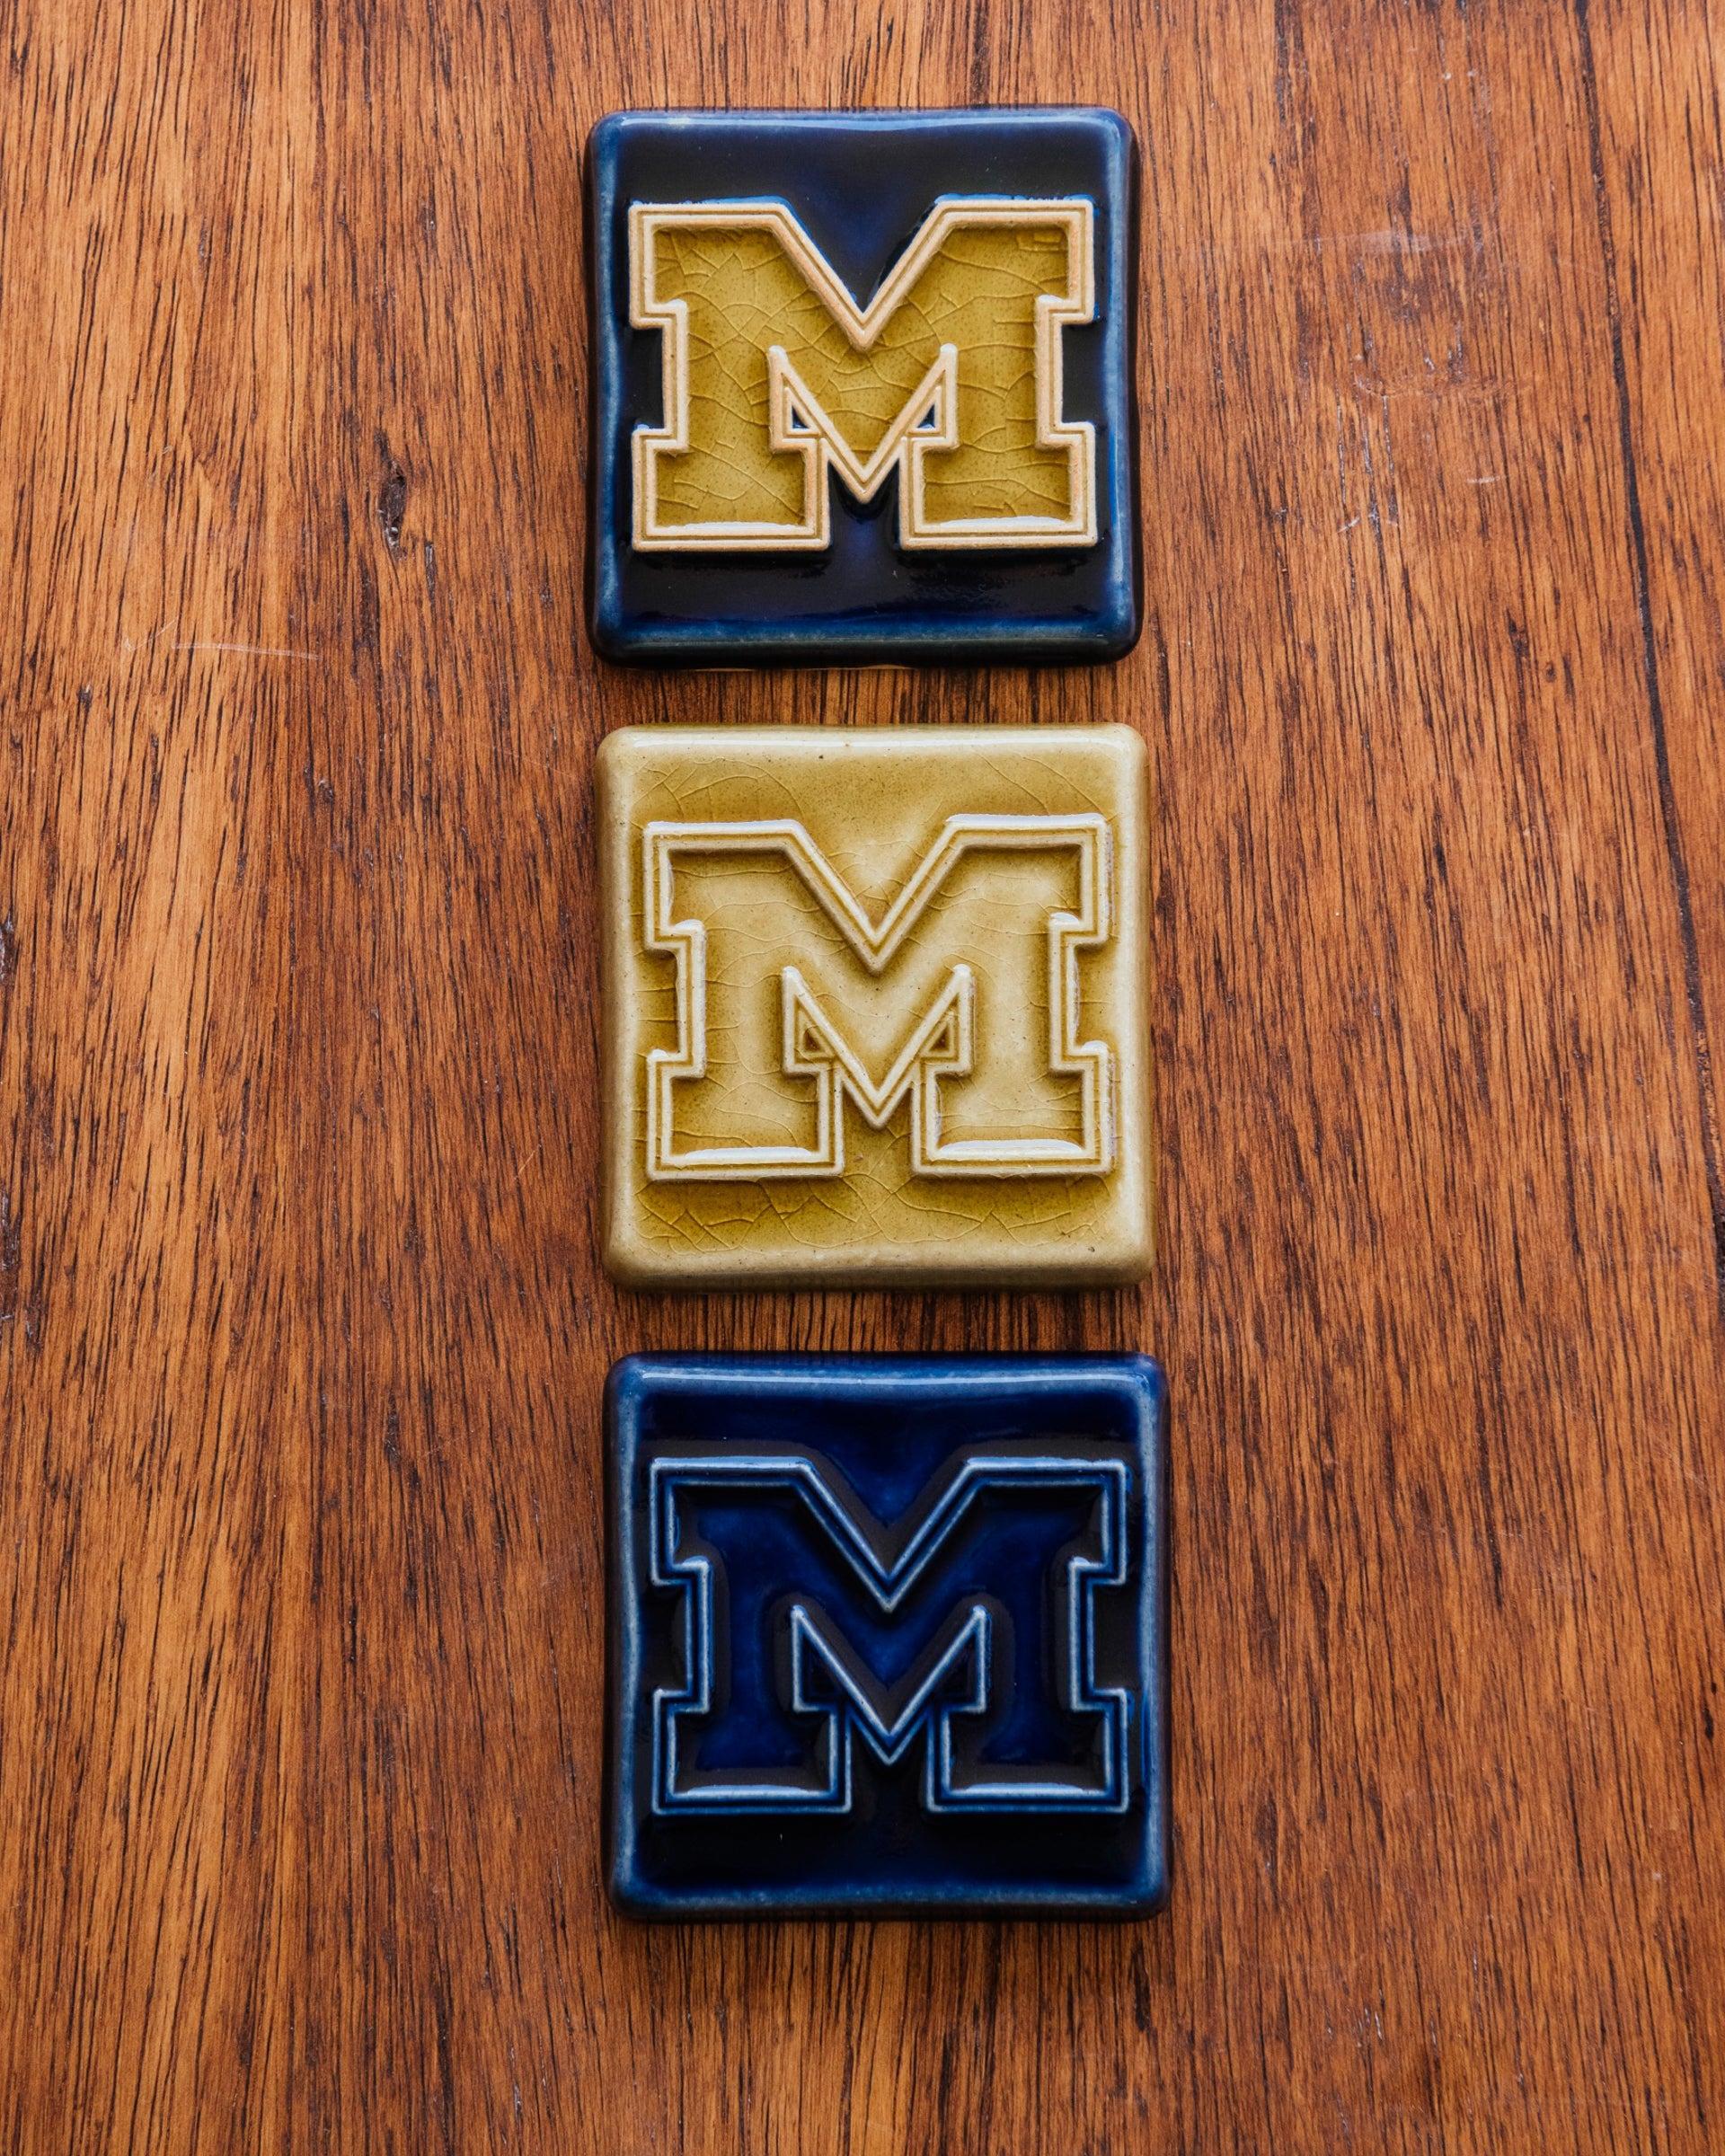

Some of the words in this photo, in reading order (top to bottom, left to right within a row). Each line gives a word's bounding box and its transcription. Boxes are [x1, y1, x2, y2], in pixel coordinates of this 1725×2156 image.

[628, 199, 1098, 552] M
[643, 813, 1112, 1181] M
[650, 1456, 1129, 1815] M
